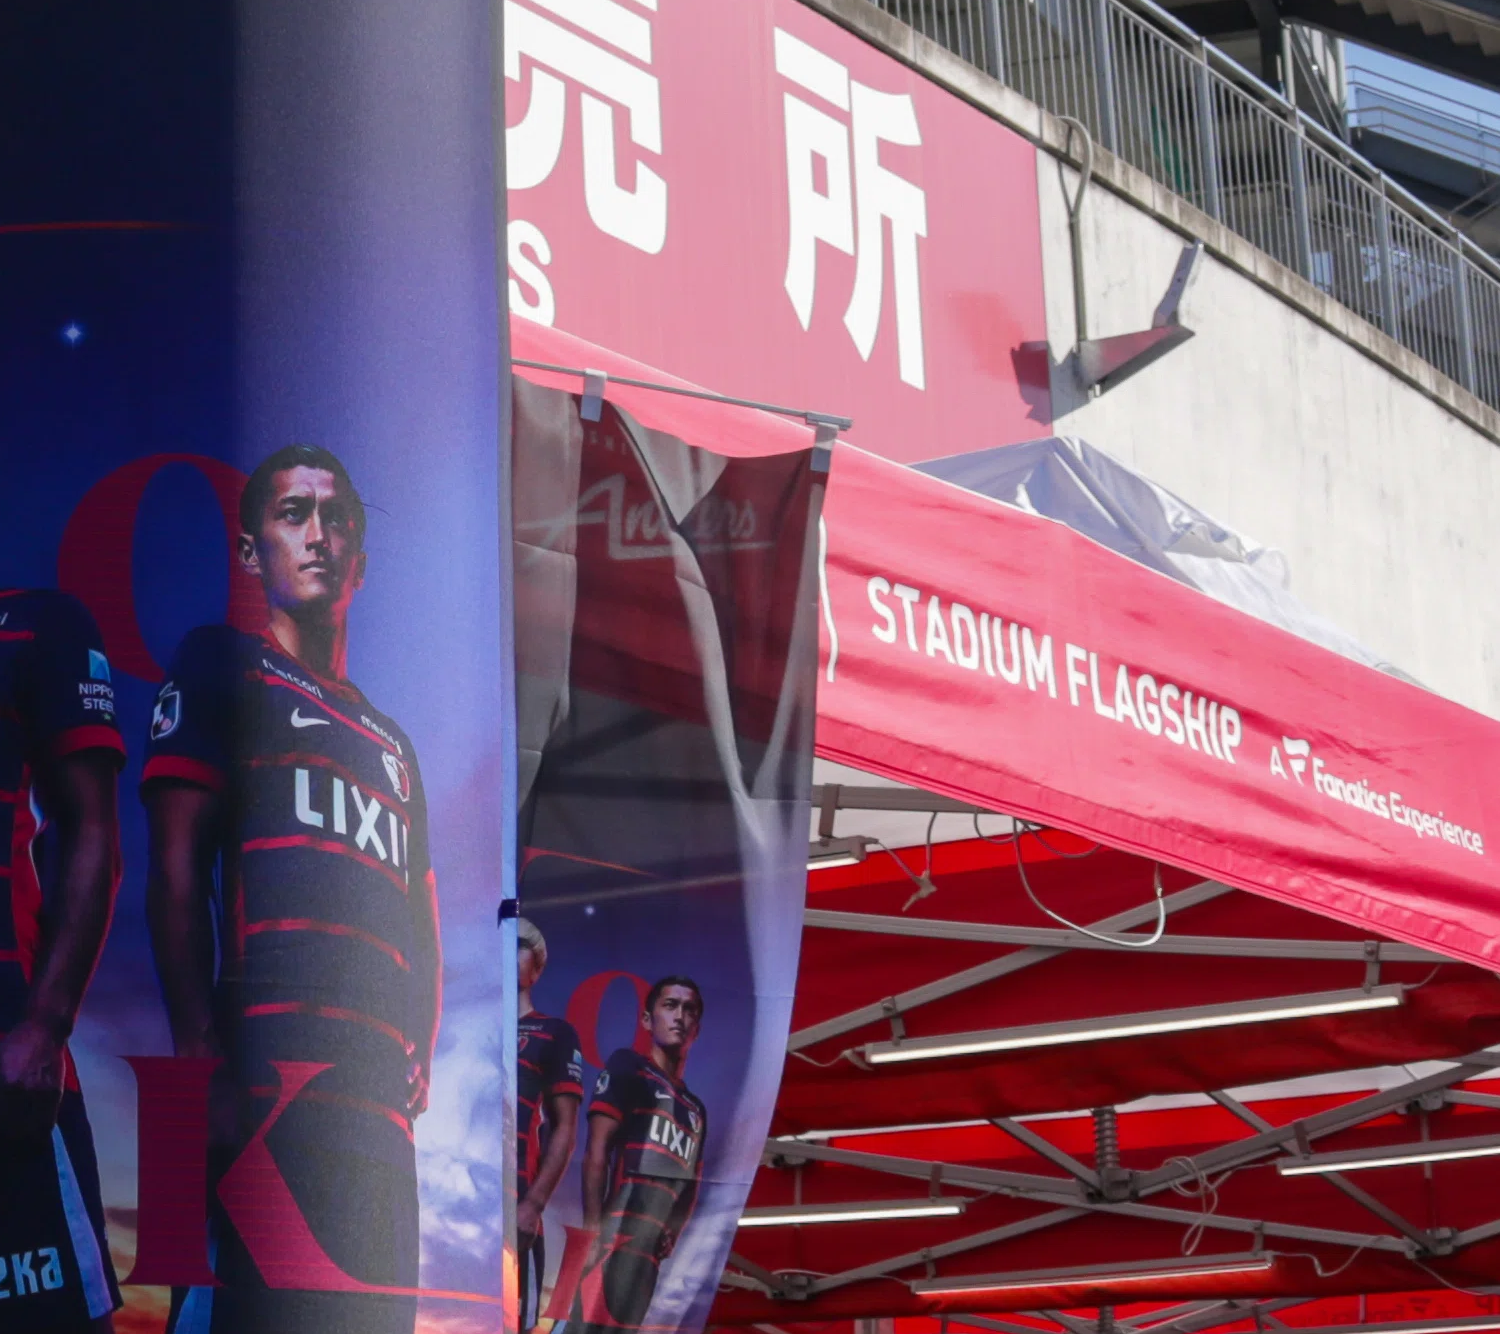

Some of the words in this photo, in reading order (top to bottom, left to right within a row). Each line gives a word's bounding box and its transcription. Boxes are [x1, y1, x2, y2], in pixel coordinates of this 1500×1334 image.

[78, 681, 115, 700] NIPPO
[866, 575, 1058, 699] STADIUM
[1064, 641, 1243, 765] FLAGSHIP
[1312, 757, 1391, 818] Fanatics
[1388, 795, 1484, 856] Experience
